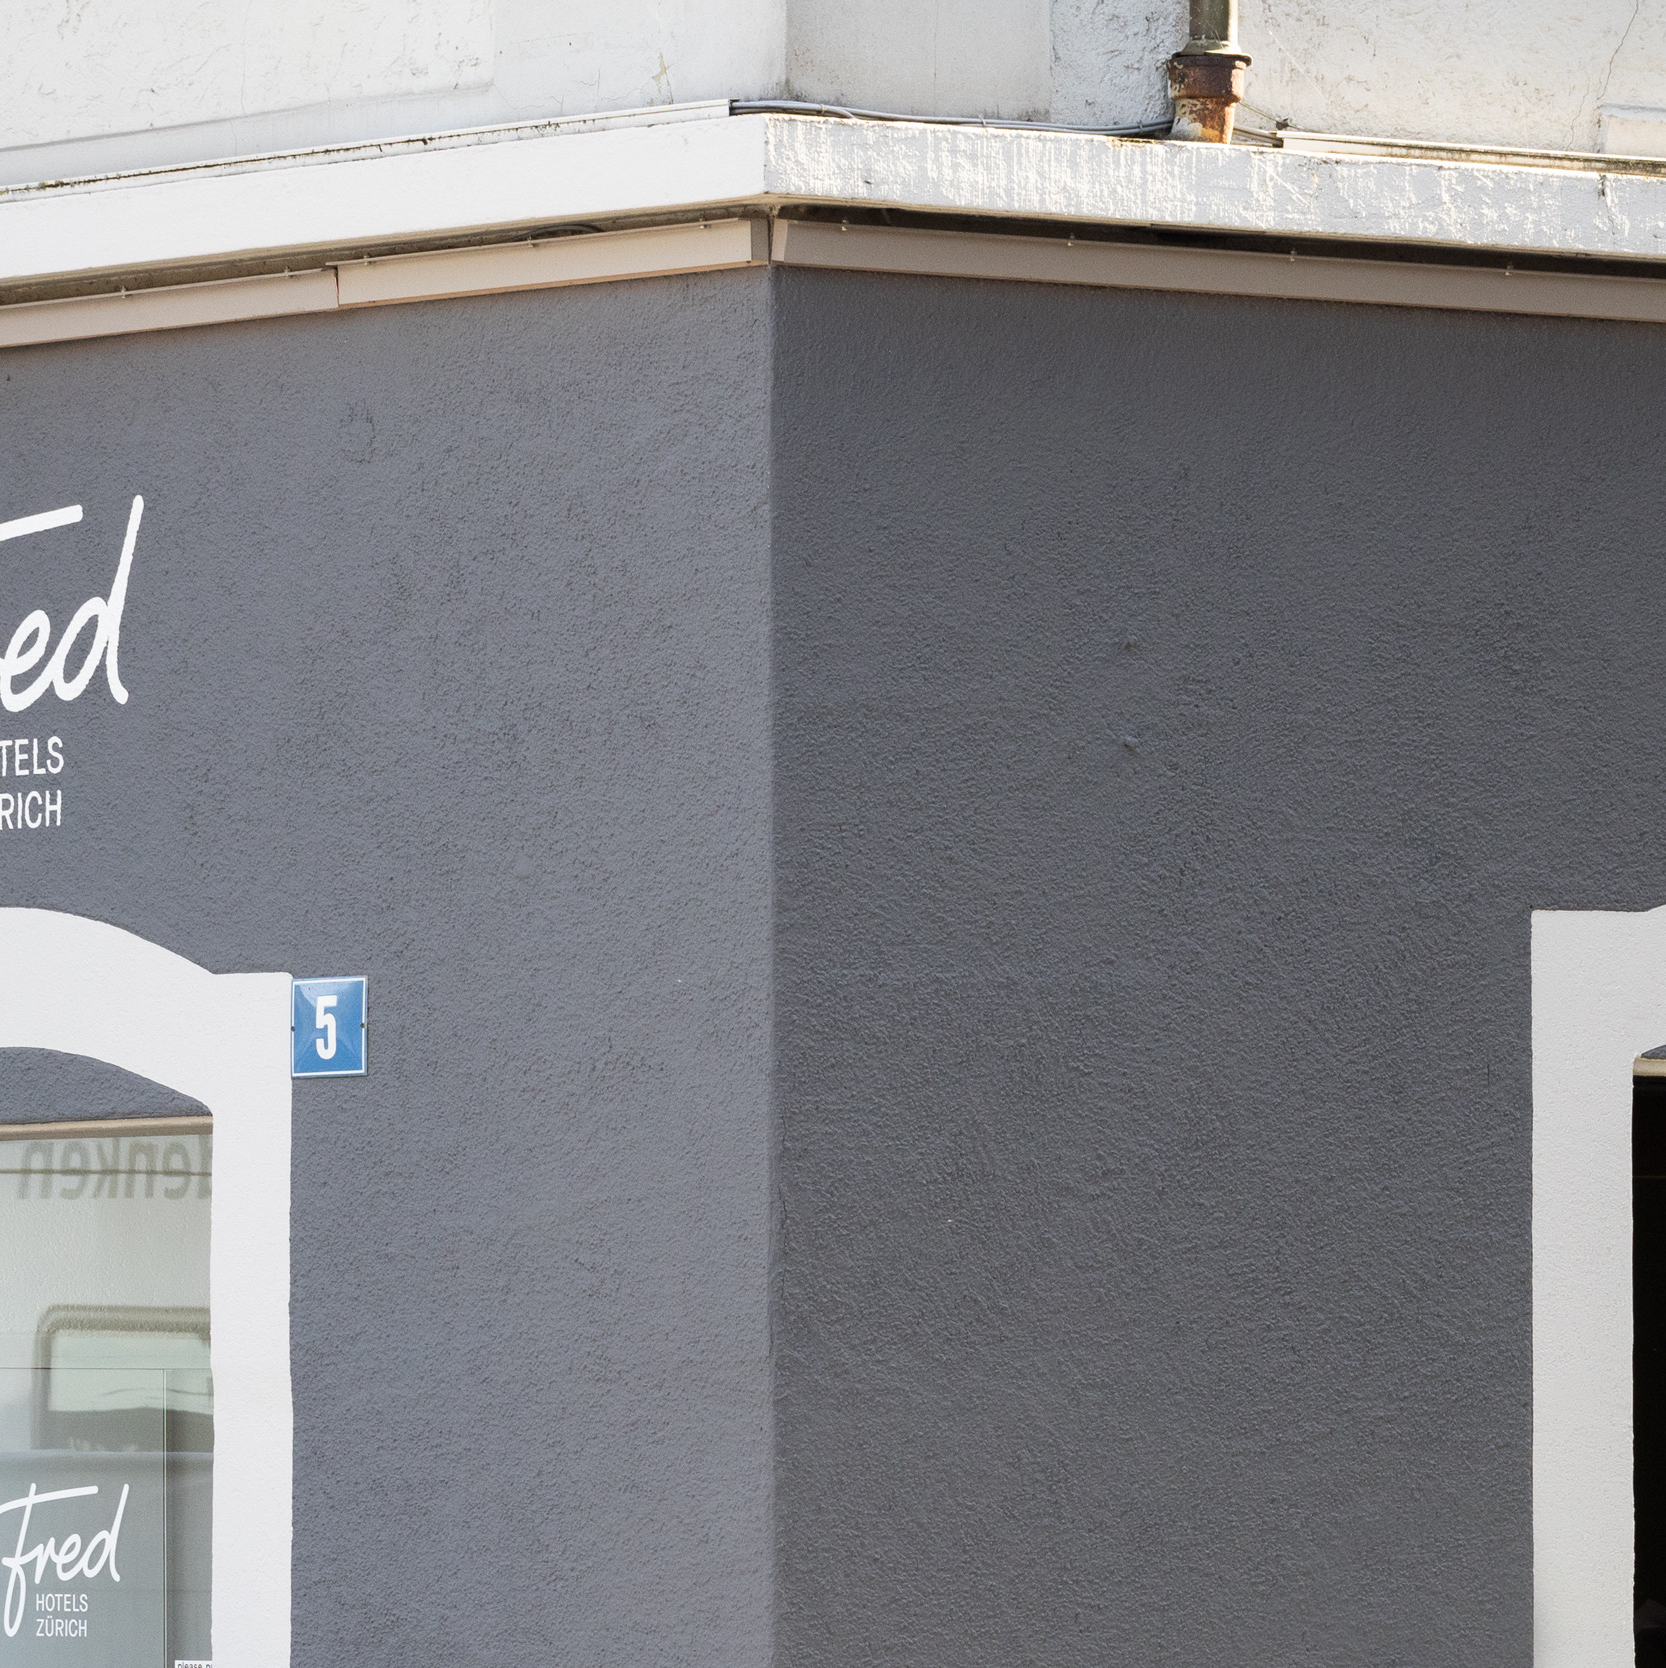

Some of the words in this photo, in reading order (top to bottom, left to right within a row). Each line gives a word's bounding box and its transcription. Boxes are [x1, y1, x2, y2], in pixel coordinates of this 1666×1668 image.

[314, 994, 339, 1061] 5
[35, 1592, 89, 1613] HOTELS
[35, 1615, 88, 1638] ZÜRICH
